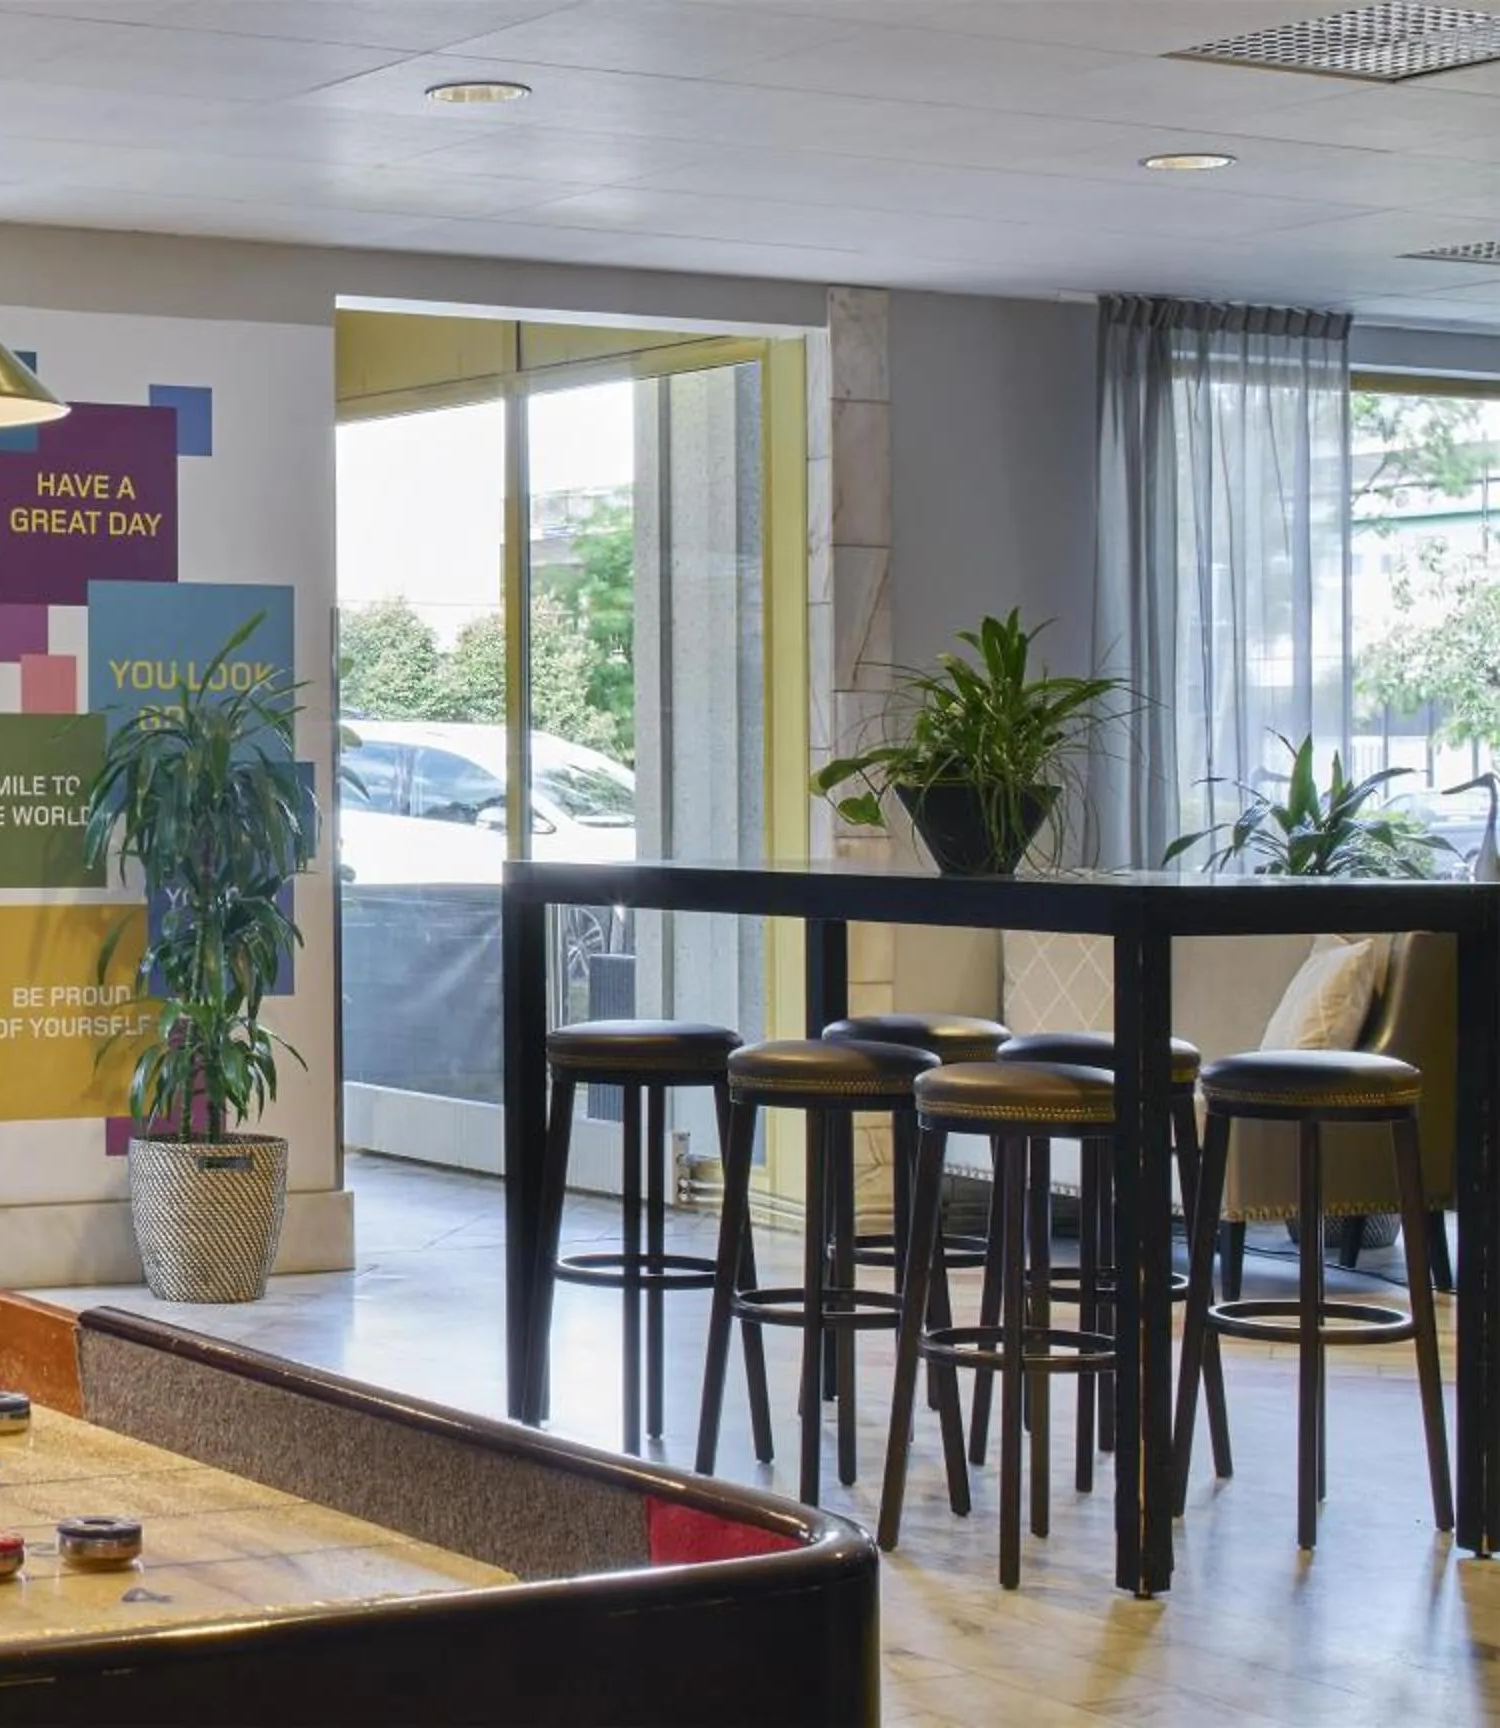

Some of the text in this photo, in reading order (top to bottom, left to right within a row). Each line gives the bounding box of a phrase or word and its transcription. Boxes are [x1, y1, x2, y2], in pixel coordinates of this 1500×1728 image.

[36, 471, 136, 499] HAVE A
[10, 507, 162, 536] GREAT DAY
[109, 659, 275, 692] YOU LOOK
[51, 775, 81, 797] TO
[12, 805, 91, 827] WORLD
[12, 985, 132, 1009] BE PROUD
[29, 1015, 152, 1039] YOURSELF
